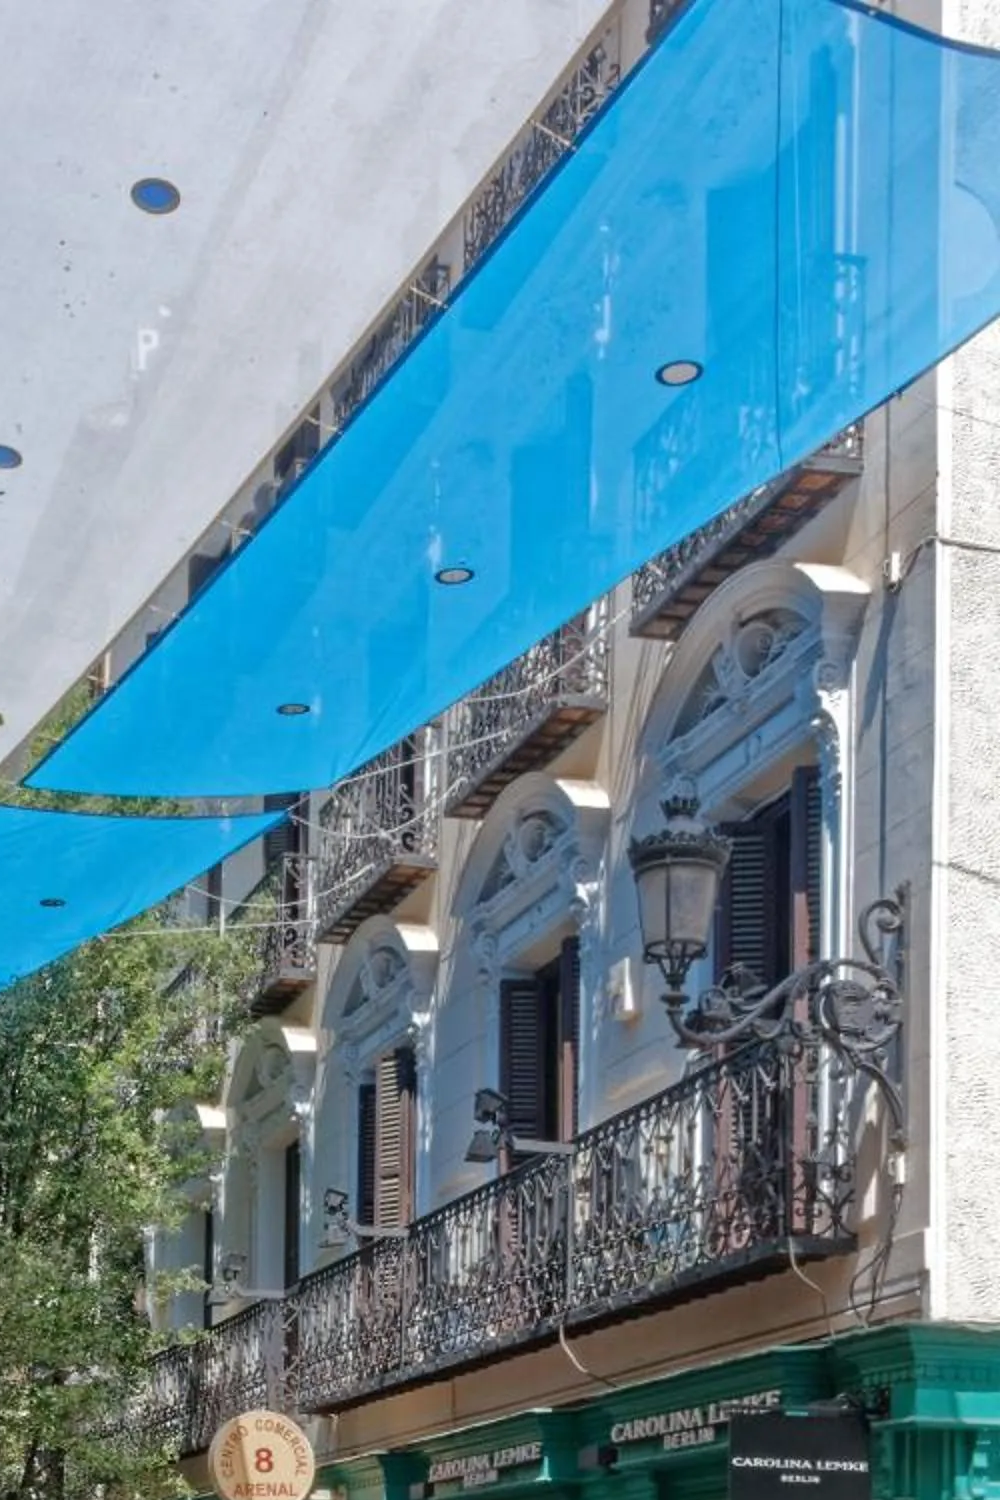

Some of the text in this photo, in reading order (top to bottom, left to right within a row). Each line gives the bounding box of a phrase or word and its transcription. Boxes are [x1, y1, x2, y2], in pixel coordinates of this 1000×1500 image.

[611, 1407, 703, 1443] CAROLINA
[663, 1427, 715, 1450] BERLIN
[221, 1425, 249, 1478] CENTRO
[254, 1447, 274, 1473] 8
[732, 1456, 869, 1473] CAROLINA LEMKE
[233, 1482, 298, 1497] ARENAL
[780, 1474, 821, 1484] BERLIN
